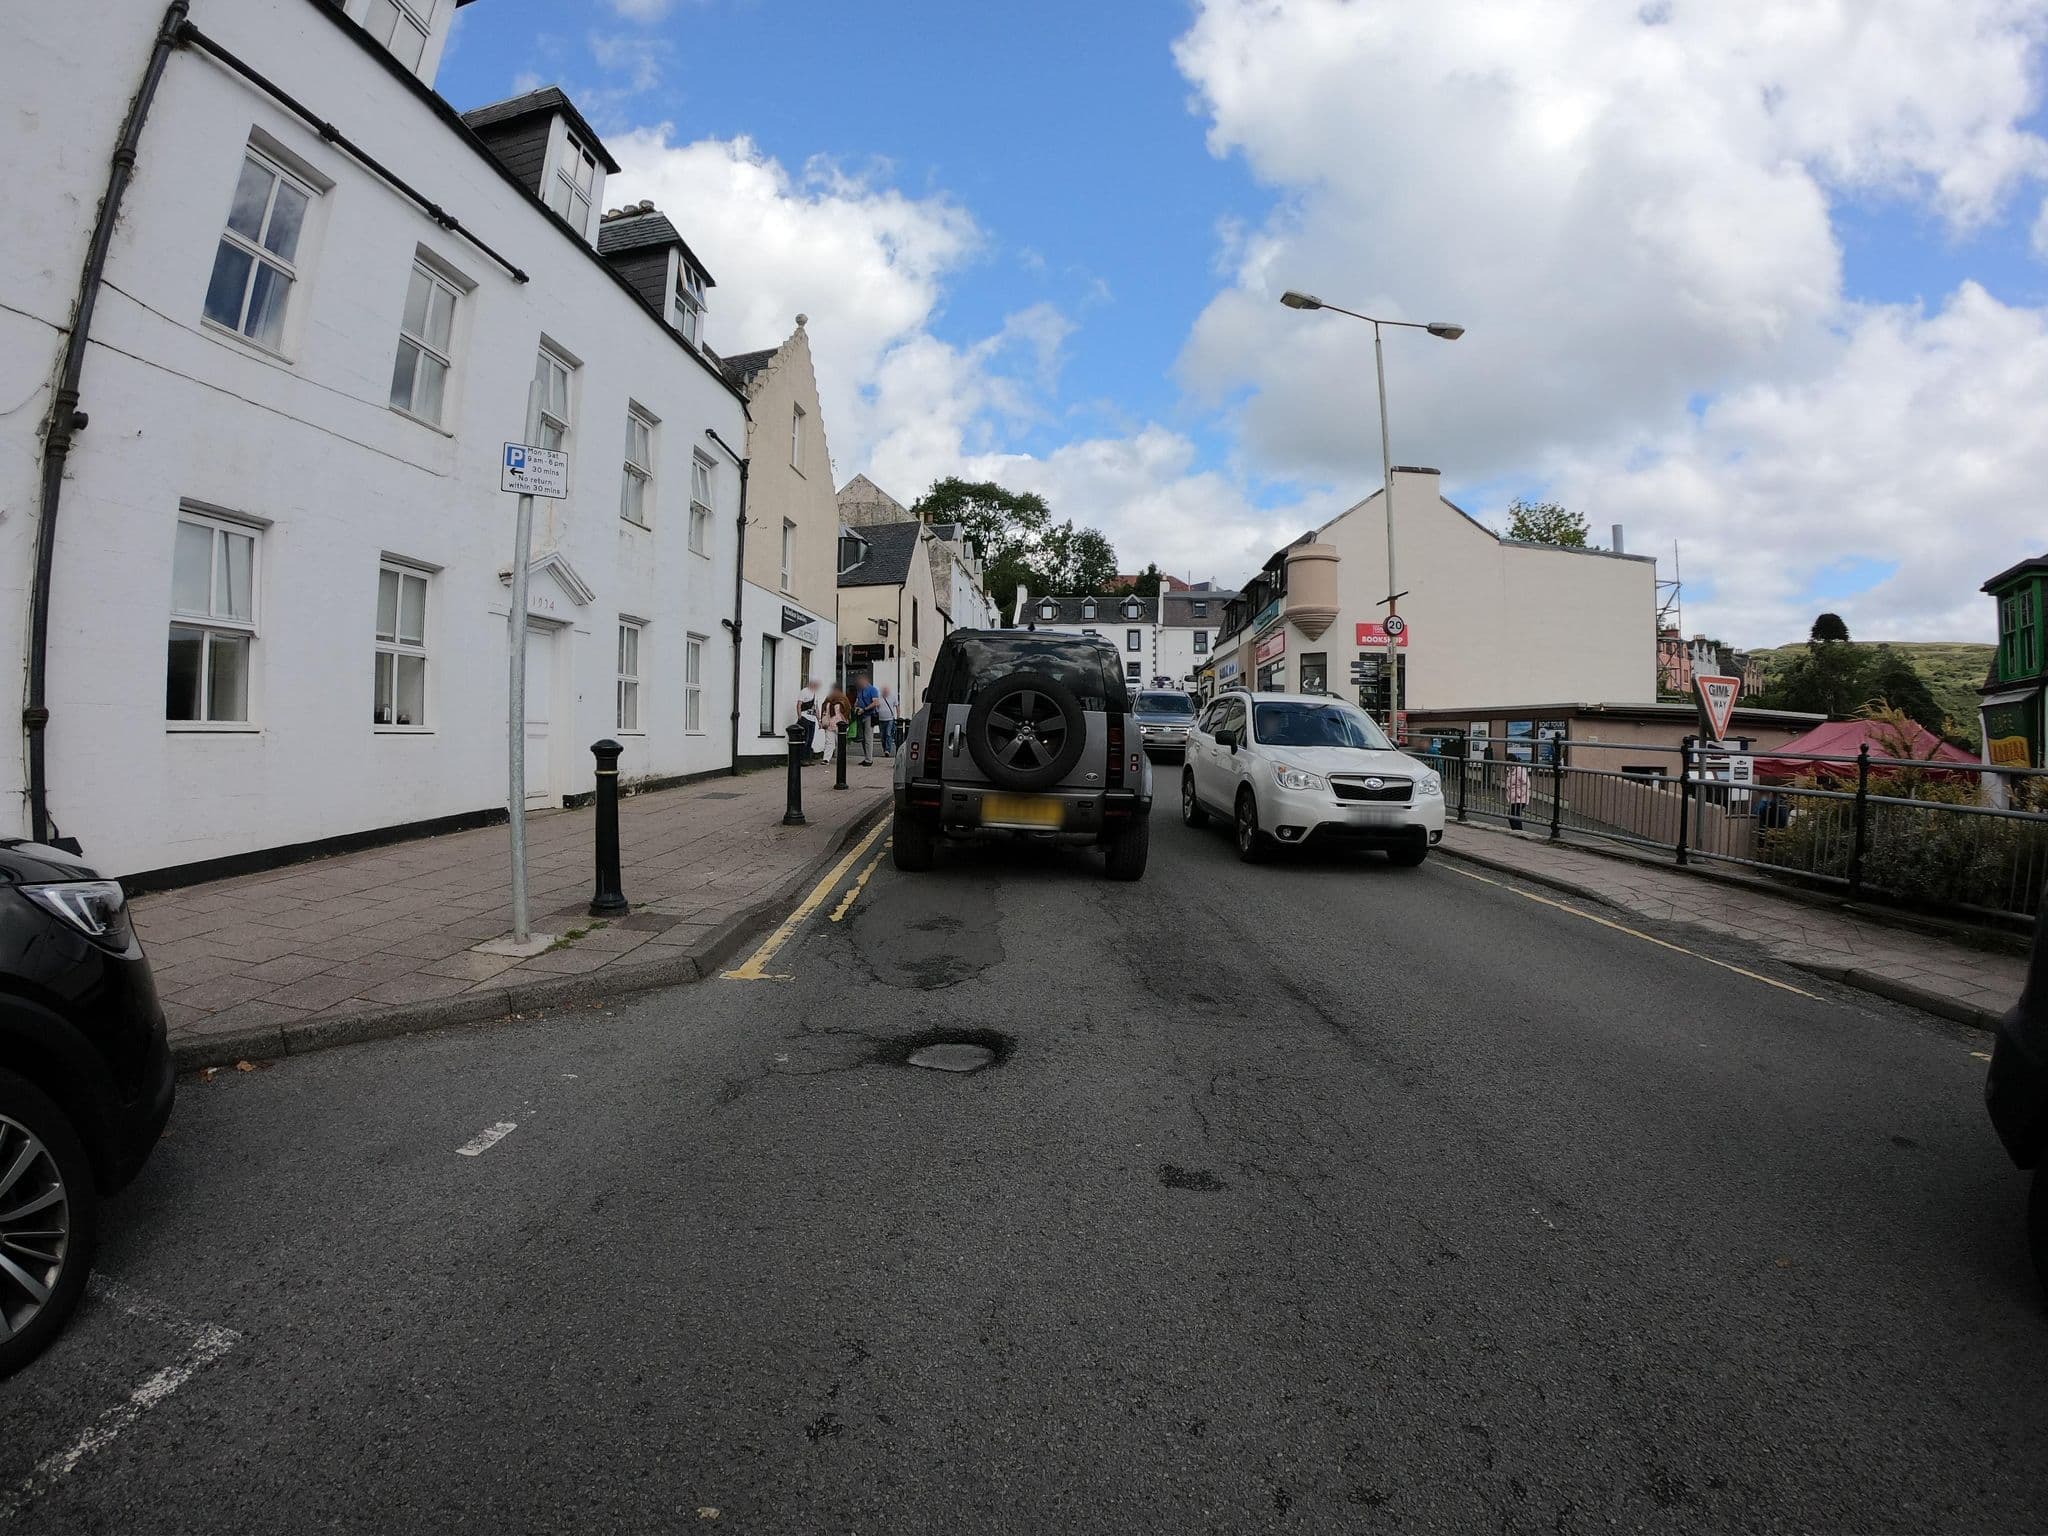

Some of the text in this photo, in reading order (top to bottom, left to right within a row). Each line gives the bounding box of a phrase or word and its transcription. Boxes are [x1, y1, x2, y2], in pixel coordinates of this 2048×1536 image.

[511, 449, 523, 466] P
[527, 448, 542, 456] Mon
[547, 451, 559, 459] Sat
[530, 478, 552, 486] return
[509, 482, 530, 491] within
[544, 487, 560, 495] mins
[1388, 620, 1402, 630] 20
[1708, 684, 1730, 697] GIVE
[1713, 700, 1727, 709] WAY
